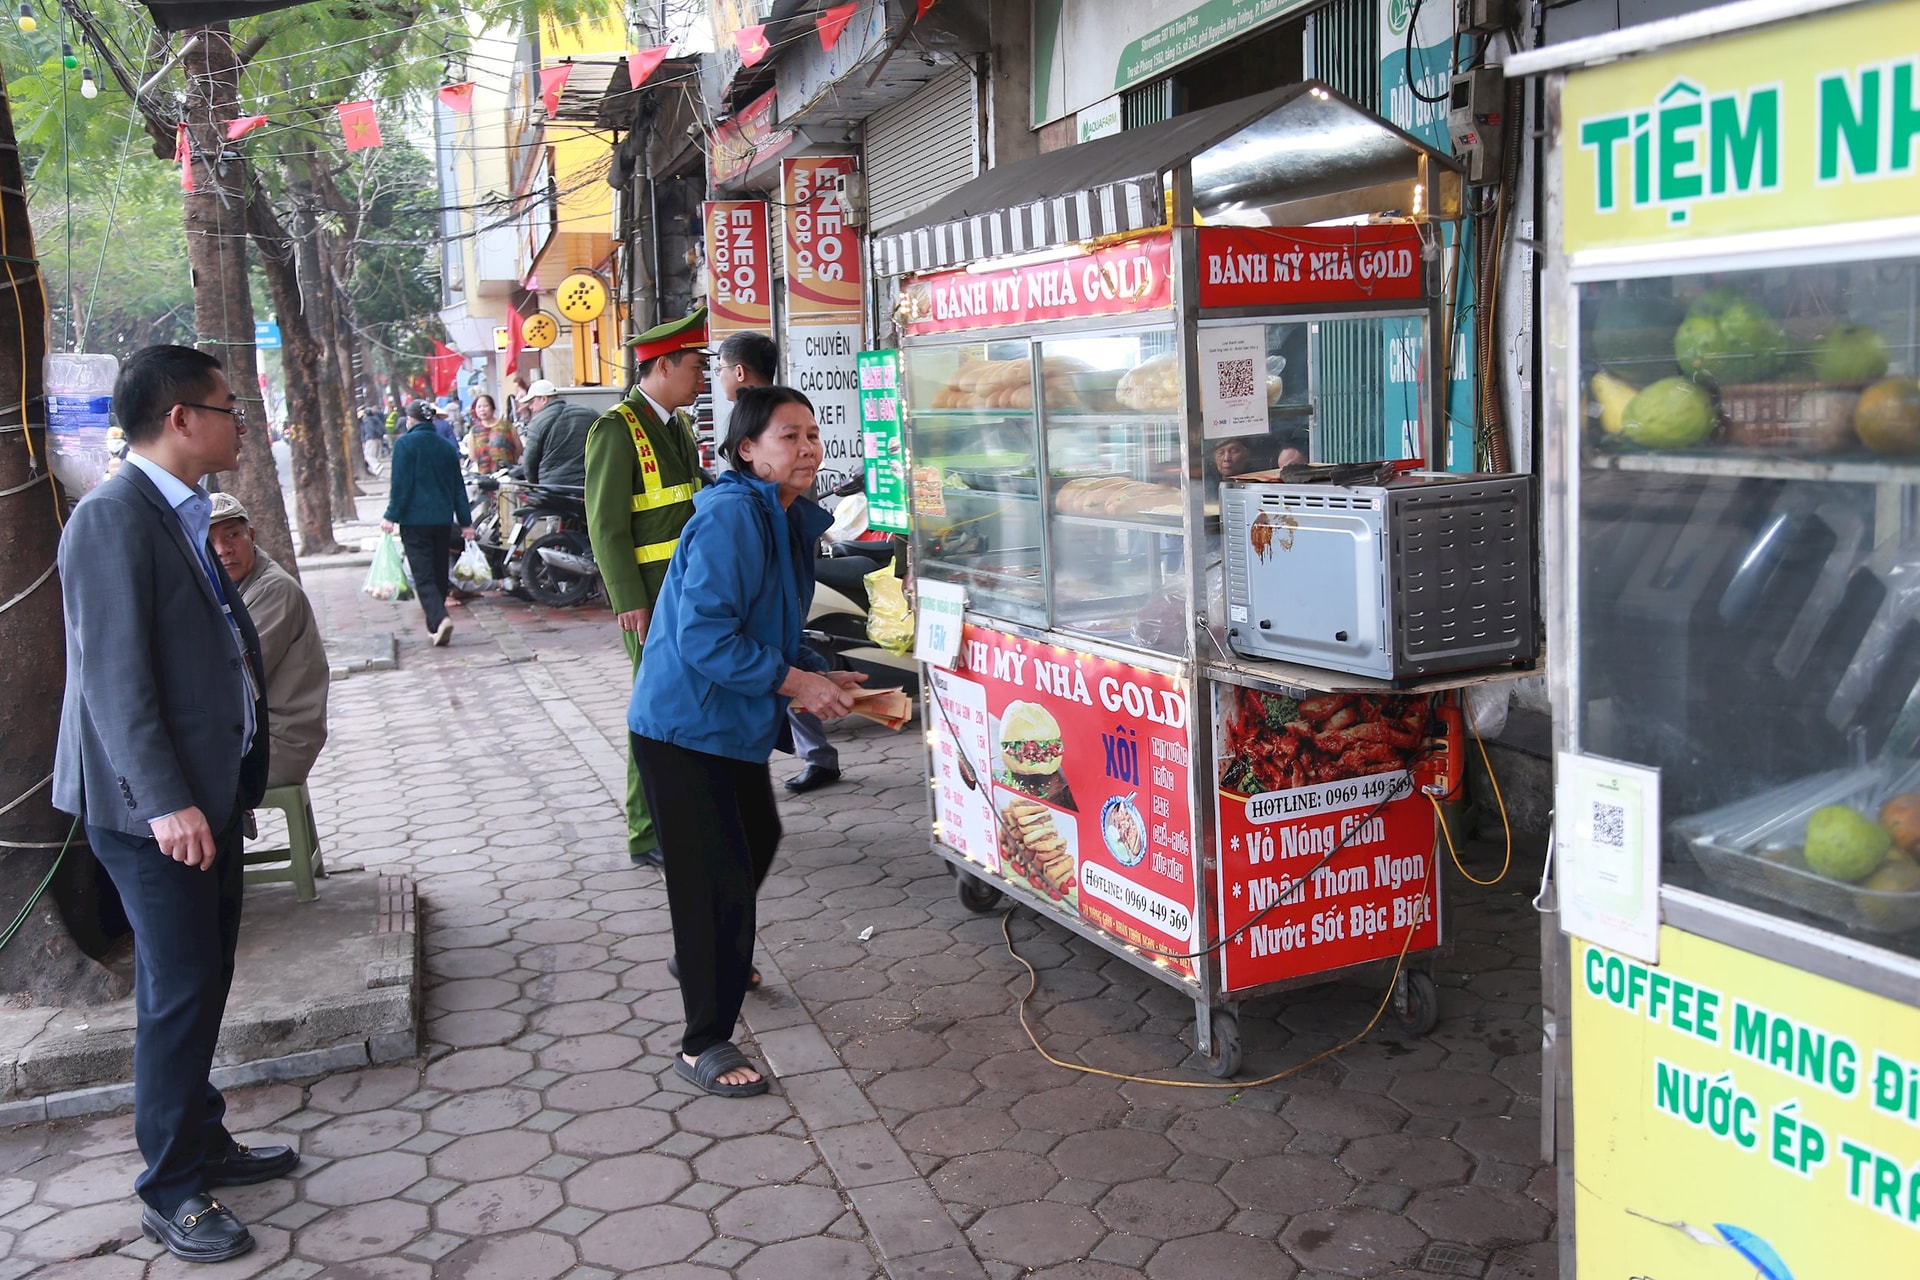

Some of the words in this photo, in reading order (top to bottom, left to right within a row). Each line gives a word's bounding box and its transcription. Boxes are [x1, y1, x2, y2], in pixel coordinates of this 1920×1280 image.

[794, 168, 812, 244] MOTOR
[815, 167, 843, 283] ENEOS
[714, 210, 730, 273] MOTOR
[731, 209, 756, 306] ENEOS
[796, 249, 813, 283] OIL
[1208, 246, 1268, 285] BÁNH
[1273, 244, 1305, 282] MỲ
[1309, 244, 1354, 281] NHÀ
[1358, 249, 1413, 280] GOLD
[716, 277, 731, 305] OIL
[935, 276, 987, 320] BÁNH
[992, 269, 1024, 313] MỲ
[1027, 259, 1077, 309] NHÀ
[1082, 255, 1154, 303] GOLD
[805, 331, 851, 356] CHUYÊN
[1389, 320, 1416, 383] CHẤT
[800, 366, 824, 391] CÁC
[826, 365, 858, 390] DÒNG
[625, 411, 656, 474] CAHN
[819, 405, 833, 425] XE
[836, 405, 846, 424] FI
[824, 434, 847, 459] XÓA
[993, 643, 1027, 686] MỲ
[1033, 659, 1093, 706] NHÀ
[1099, 676, 1186, 729] GOLD
[1152, 795, 1170, 819] PATE
[1252, 793, 1321, 818] HOTLINE:
[1326, 786, 1357, 805] 0969
[1362, 780, 1385, 799] 449
[1389, 776, 1411, 797] 569
[1246, 828, 1274, 864] Vỏ
[1280, 822, 1335, 858] Nóng
[1341, 812, 1385, 848] Giòn
[1085, 868, 1123, 901] HOTLINE:
[1125, 887, 1147, 912] 0969
[1149, 900, 1167, 922] 449
[1169, 909, 1188, 932] 569
[1248, 873, 1306, 912] Nhân
[1311, 865, 1369, 900] Thơm
[1374, 854, 1425, 890] Ngon
[1250, 919, 1306, 958] Nước
[1311, 904, 1345, 945] Sốt
[1350, 901, 1387, 940] Đặc
[1393, 893, 1432, 931] Biệt
[1586, 948, 1719, 1042] COFFEE
[1733, 1003, 1856, 1094] MANG
[1656, 1075, 1757, 1148] NƯỚC
[1772, 1103, 1825, 1174] ÉP
